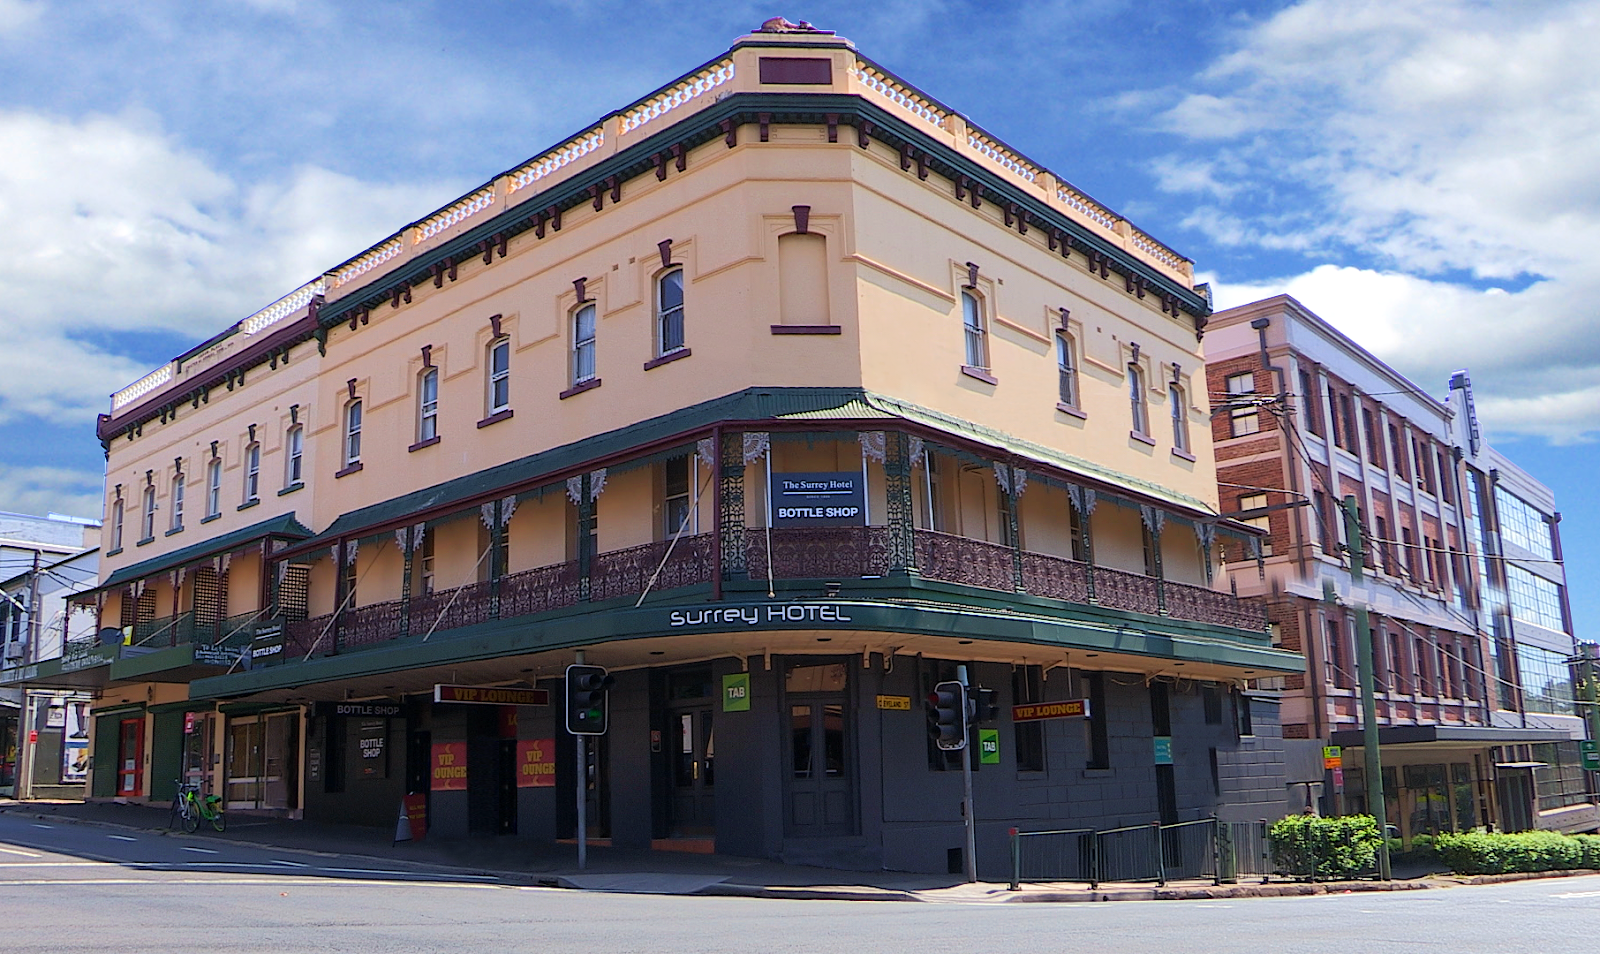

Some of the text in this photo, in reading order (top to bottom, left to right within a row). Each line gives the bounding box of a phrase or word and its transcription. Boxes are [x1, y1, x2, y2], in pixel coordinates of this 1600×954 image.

[782, 480, 853, 490] The Surrey Hotel
[778, 507, 859, 518] BOTTLE SHOP
[767, 605, 852, 622] HOTEL
[252, 647, 270, 658] BOTTLE
[269, 644, 282, 655] SHOP
[453, 688, 535, 703] VIP LOUNGE
[727, 686, 746, 699] TAB
[337, 705, 400, 715] BOTTLE SHOP
[1015, 703, 1081, 718] VIP LOUNGE
[360, 738, 384, 749] BOTTLE
[982, 741, 996, 752] TAB
[363, 748, 380, 758] SHOP
[525, 750, 543, 762] VIP
[437, 753, 455, 766] VIP
